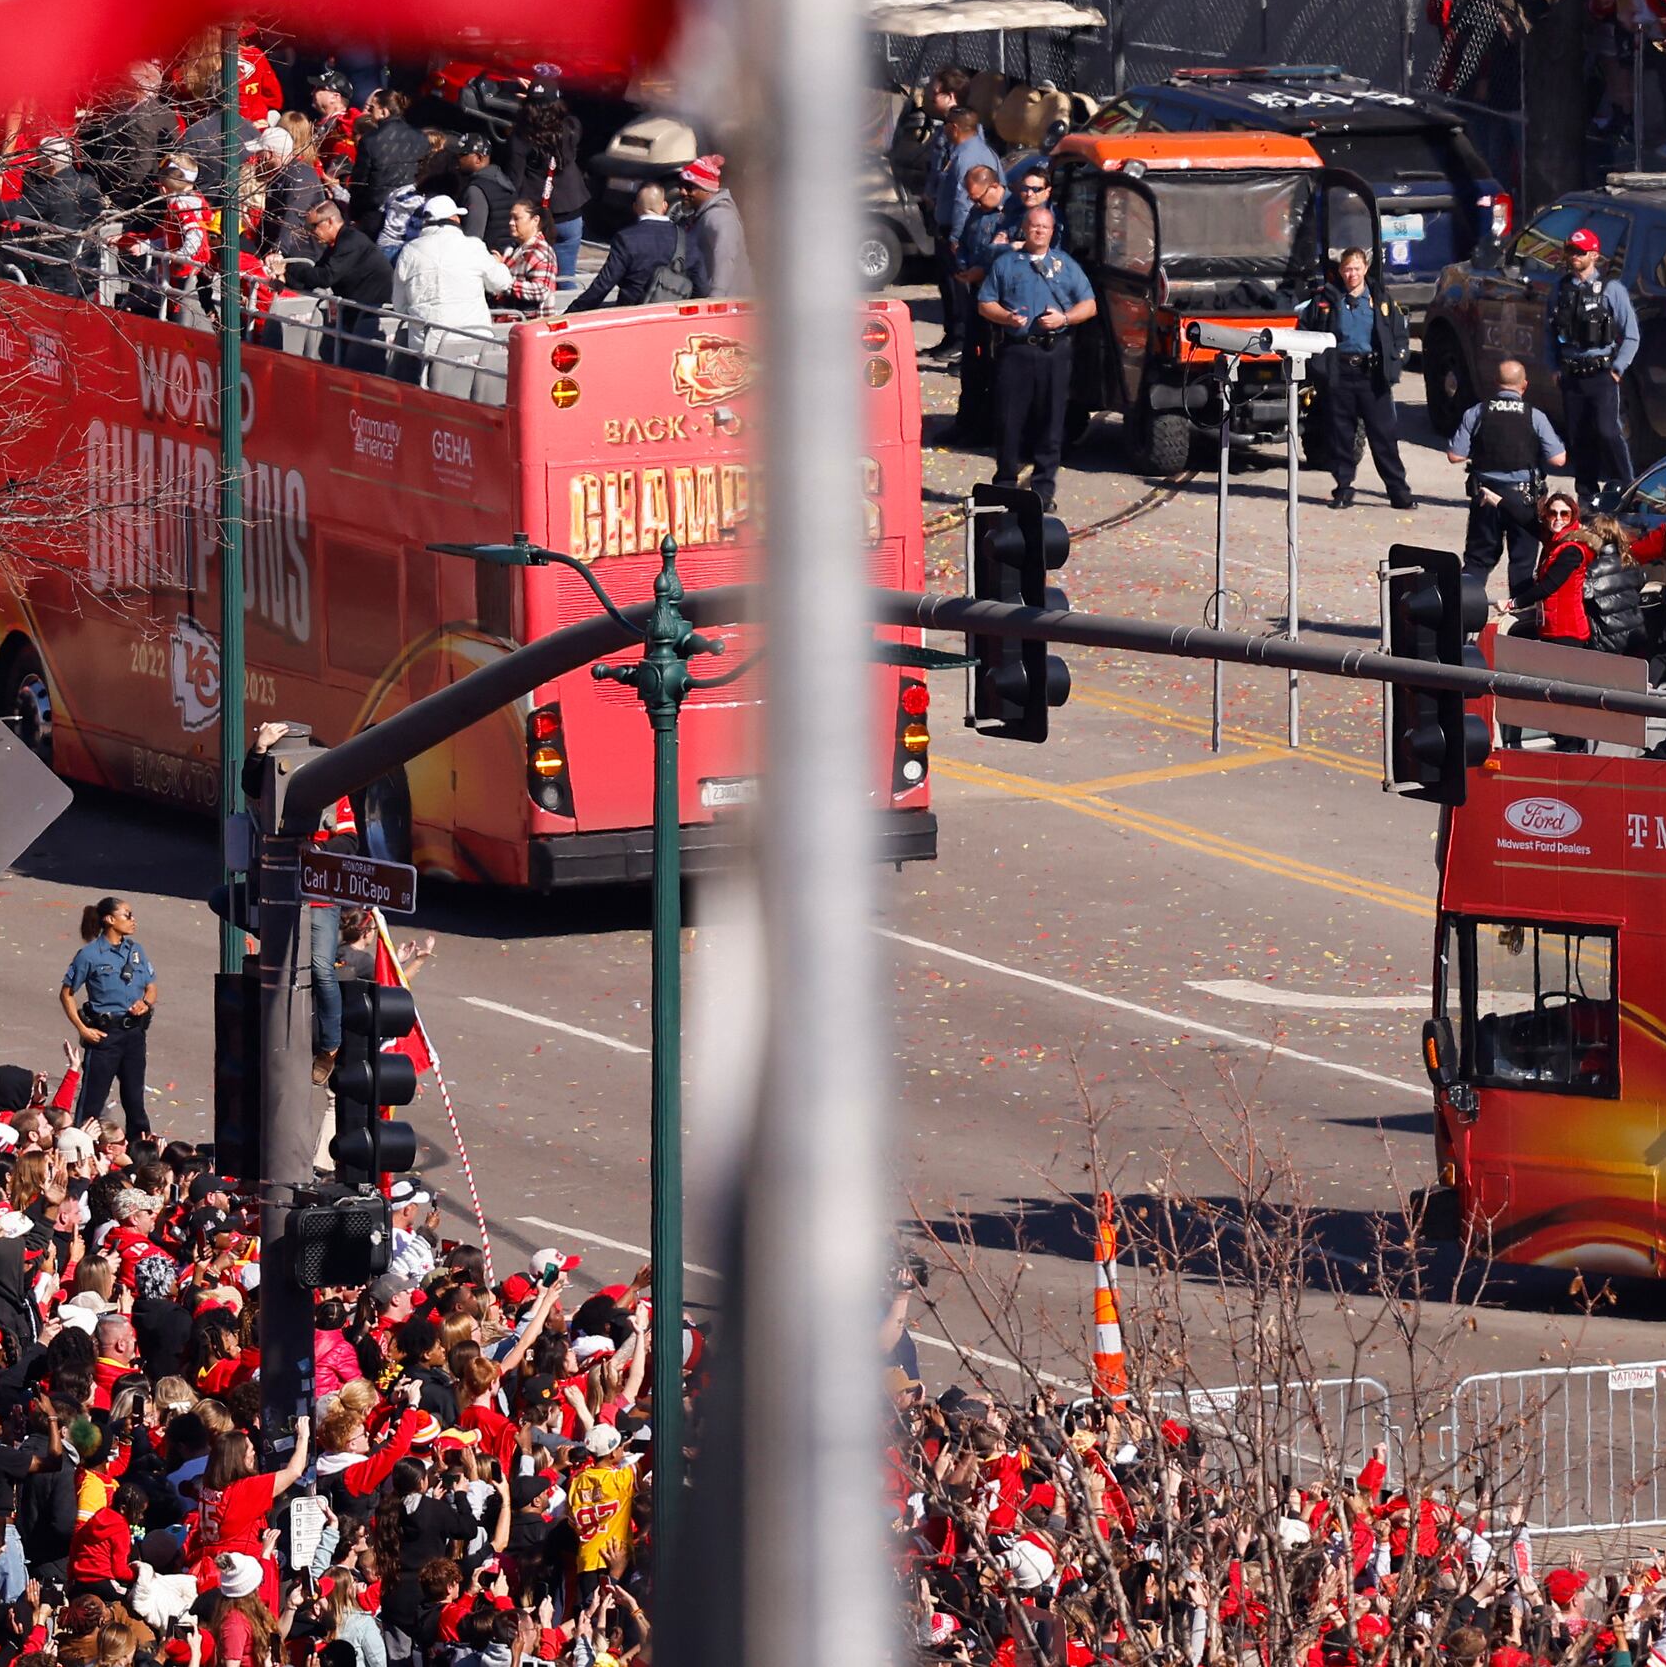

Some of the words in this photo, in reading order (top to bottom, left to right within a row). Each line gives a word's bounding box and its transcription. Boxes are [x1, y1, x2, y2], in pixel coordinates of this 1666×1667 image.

[1488, 399, 1525, 413] POLICE
[349, 408, 402, 447] Community
[602, 417, 686, 446] BACK
[87, 420, 311, 644] CHAMPONS
[131, 642, 167, 680] 2022
[1521, 802, 1565, 831] Ford
[1497, 838, 1535, 853] Midwest
[1535, 840, 1558, 853] Ford
[1558, 841, 1591, 856] Dealers
[342, 860, 375, 876] HONORARY
[303, 866, 327, 889] Carl
[333, 874, 344, 893] J.
[349, 876, 391, 902] DiCapo
[401, 891, 412, 905] DR
